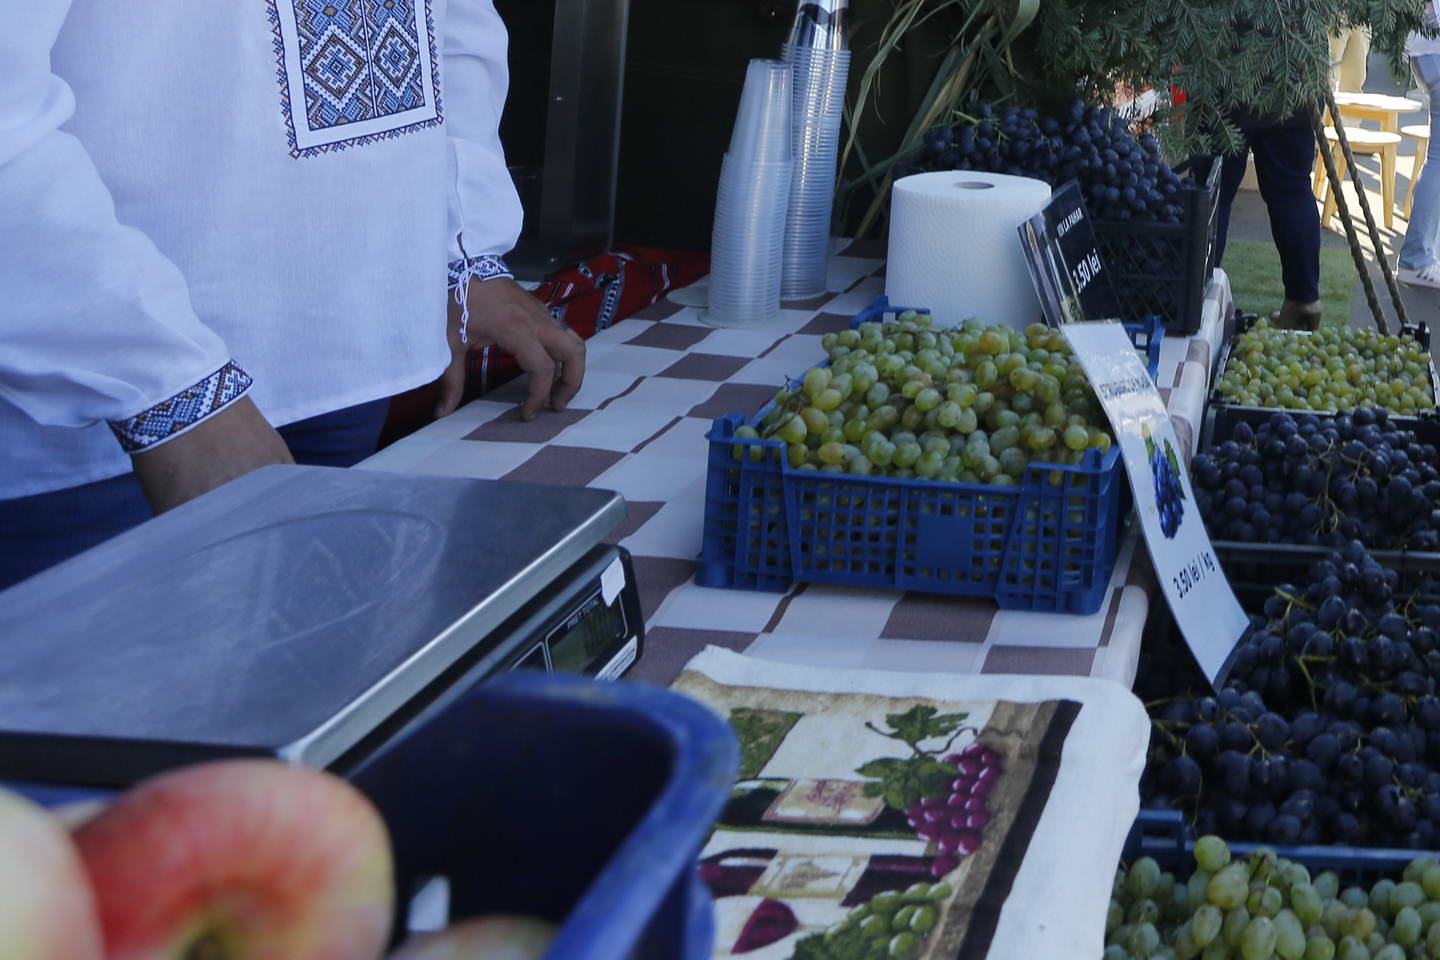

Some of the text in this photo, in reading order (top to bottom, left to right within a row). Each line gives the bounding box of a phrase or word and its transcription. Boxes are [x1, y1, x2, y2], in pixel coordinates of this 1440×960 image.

[1072, 248, 1101, 294] 3.50 lei
[1173, 568, 1192, 598] 3.50
[1187, 557, 1200, 584] lei
